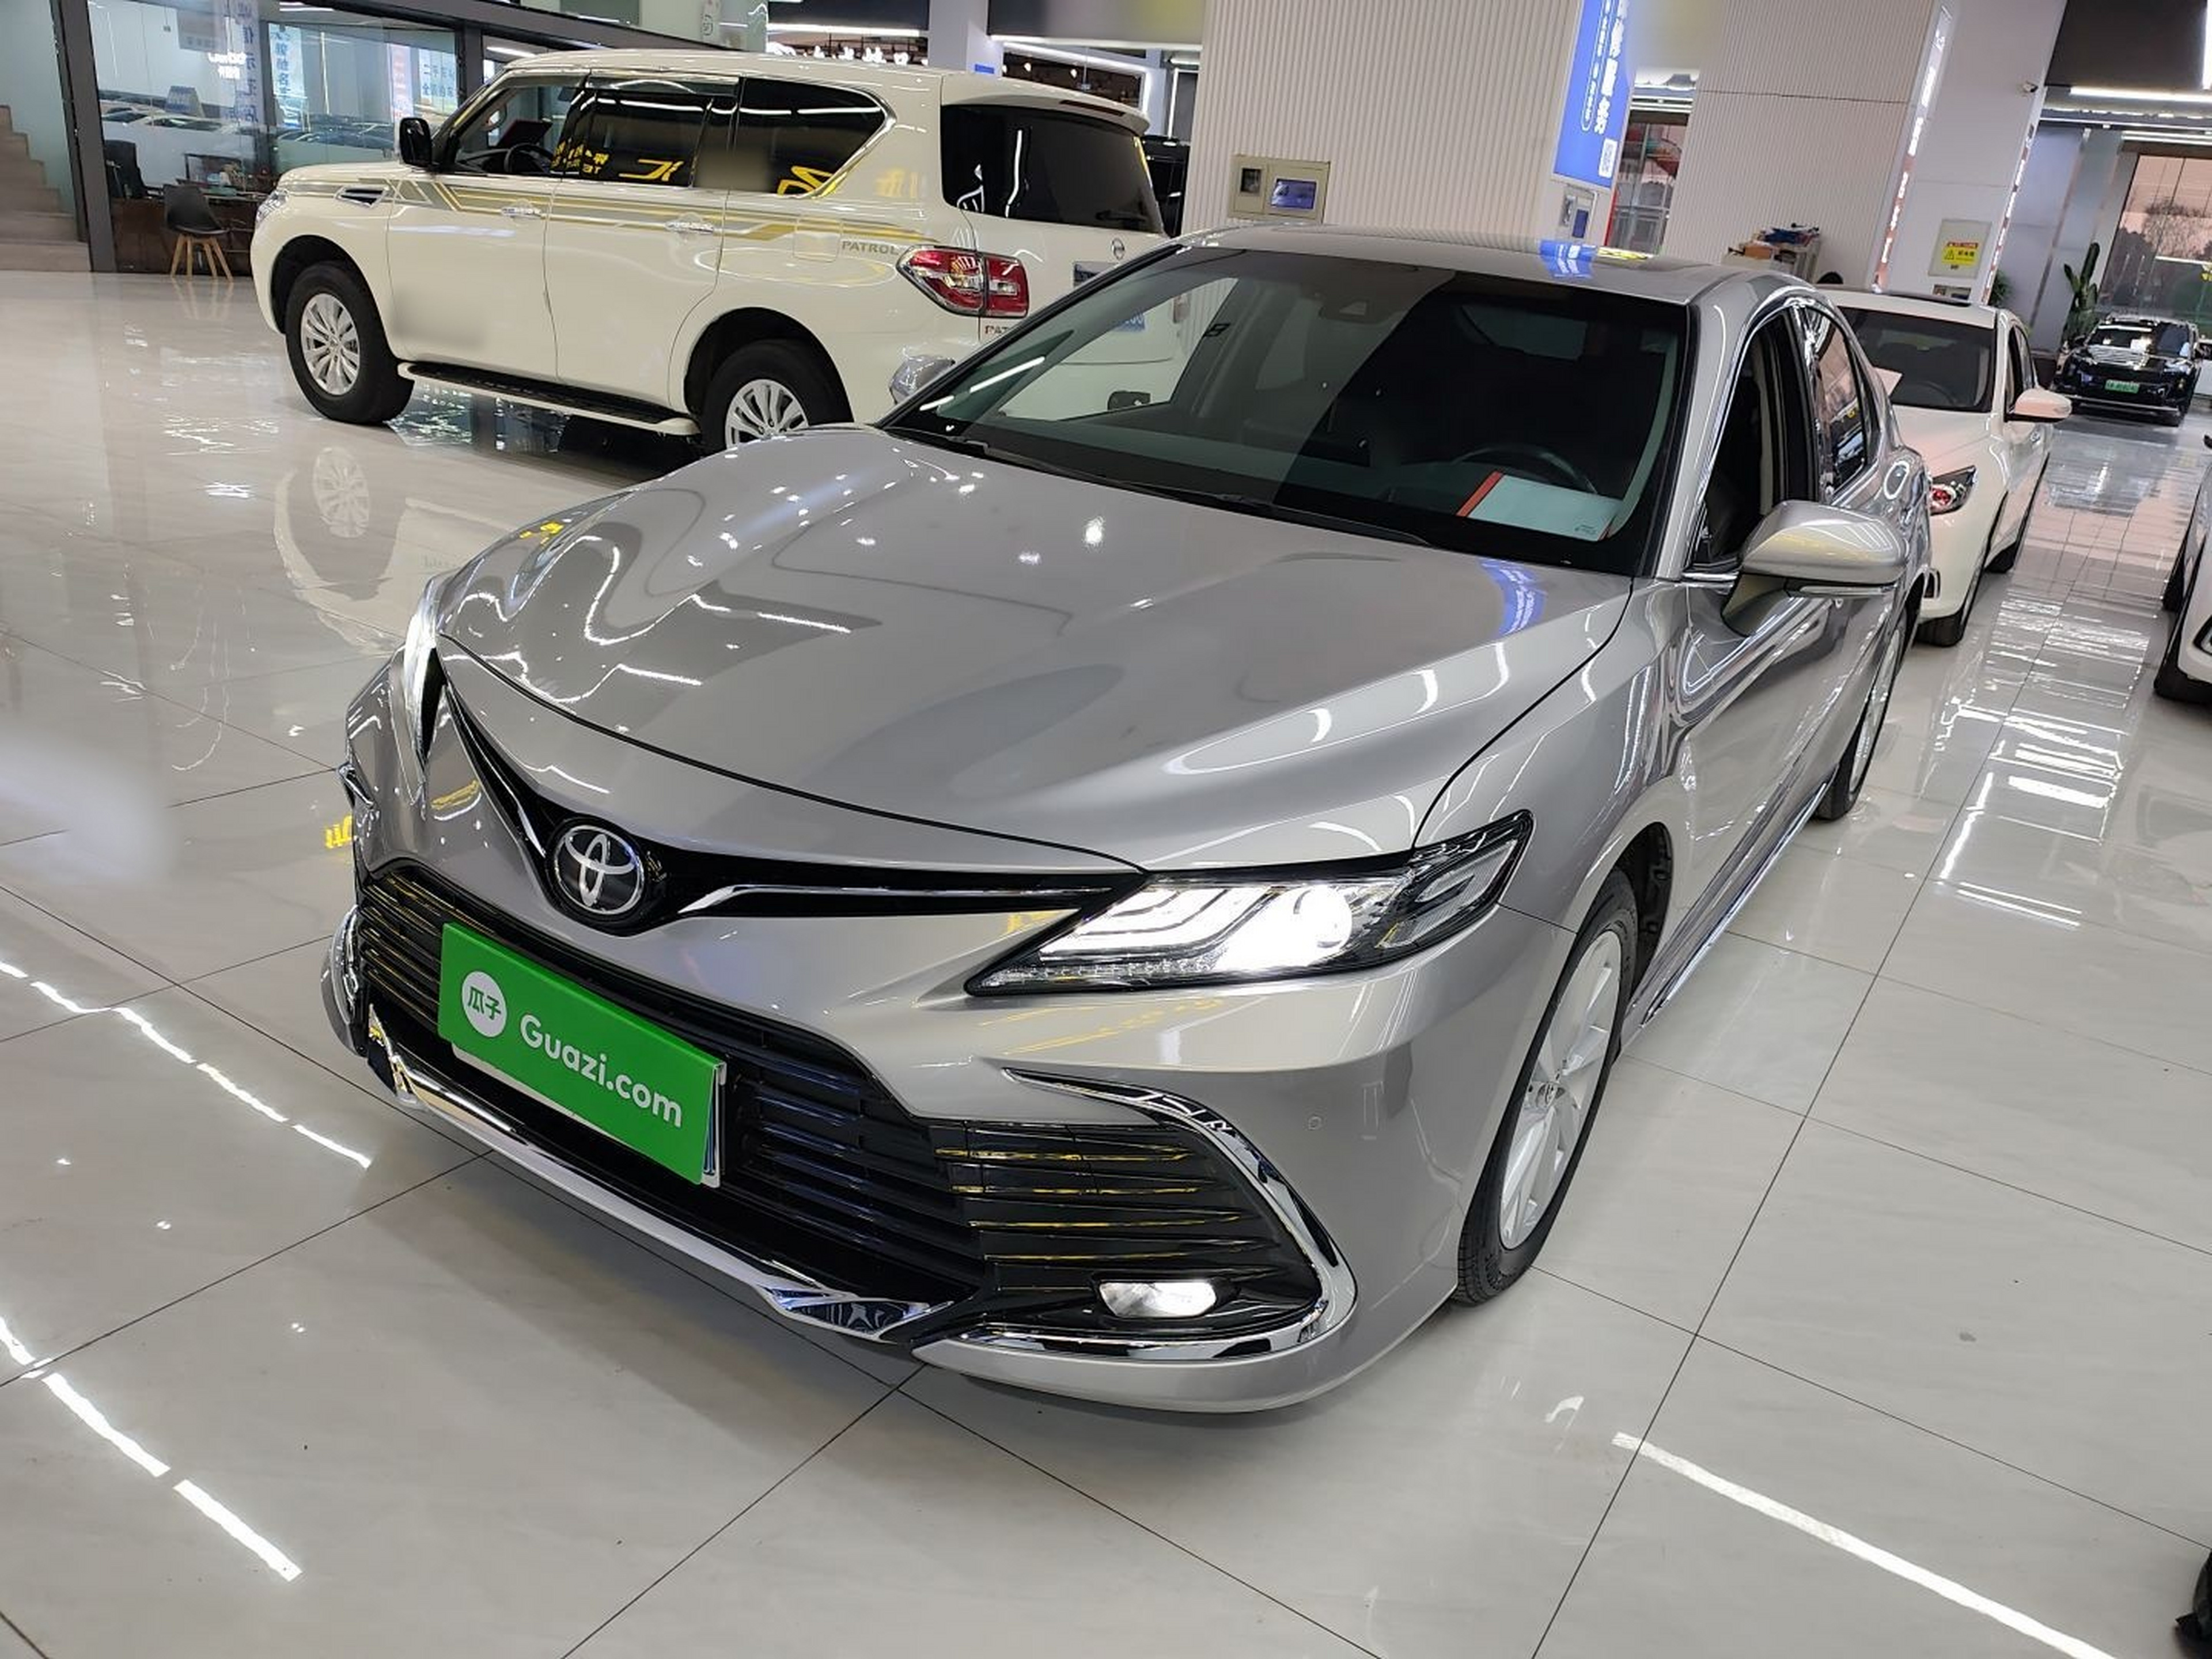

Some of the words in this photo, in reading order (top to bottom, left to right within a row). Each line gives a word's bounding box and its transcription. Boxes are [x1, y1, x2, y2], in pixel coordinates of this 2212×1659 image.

[842, 241, 899, 255] PATROL
[468, 986, 502, 1020] 瓜子
[520, 1014, 682, 1128] Guazi.com
